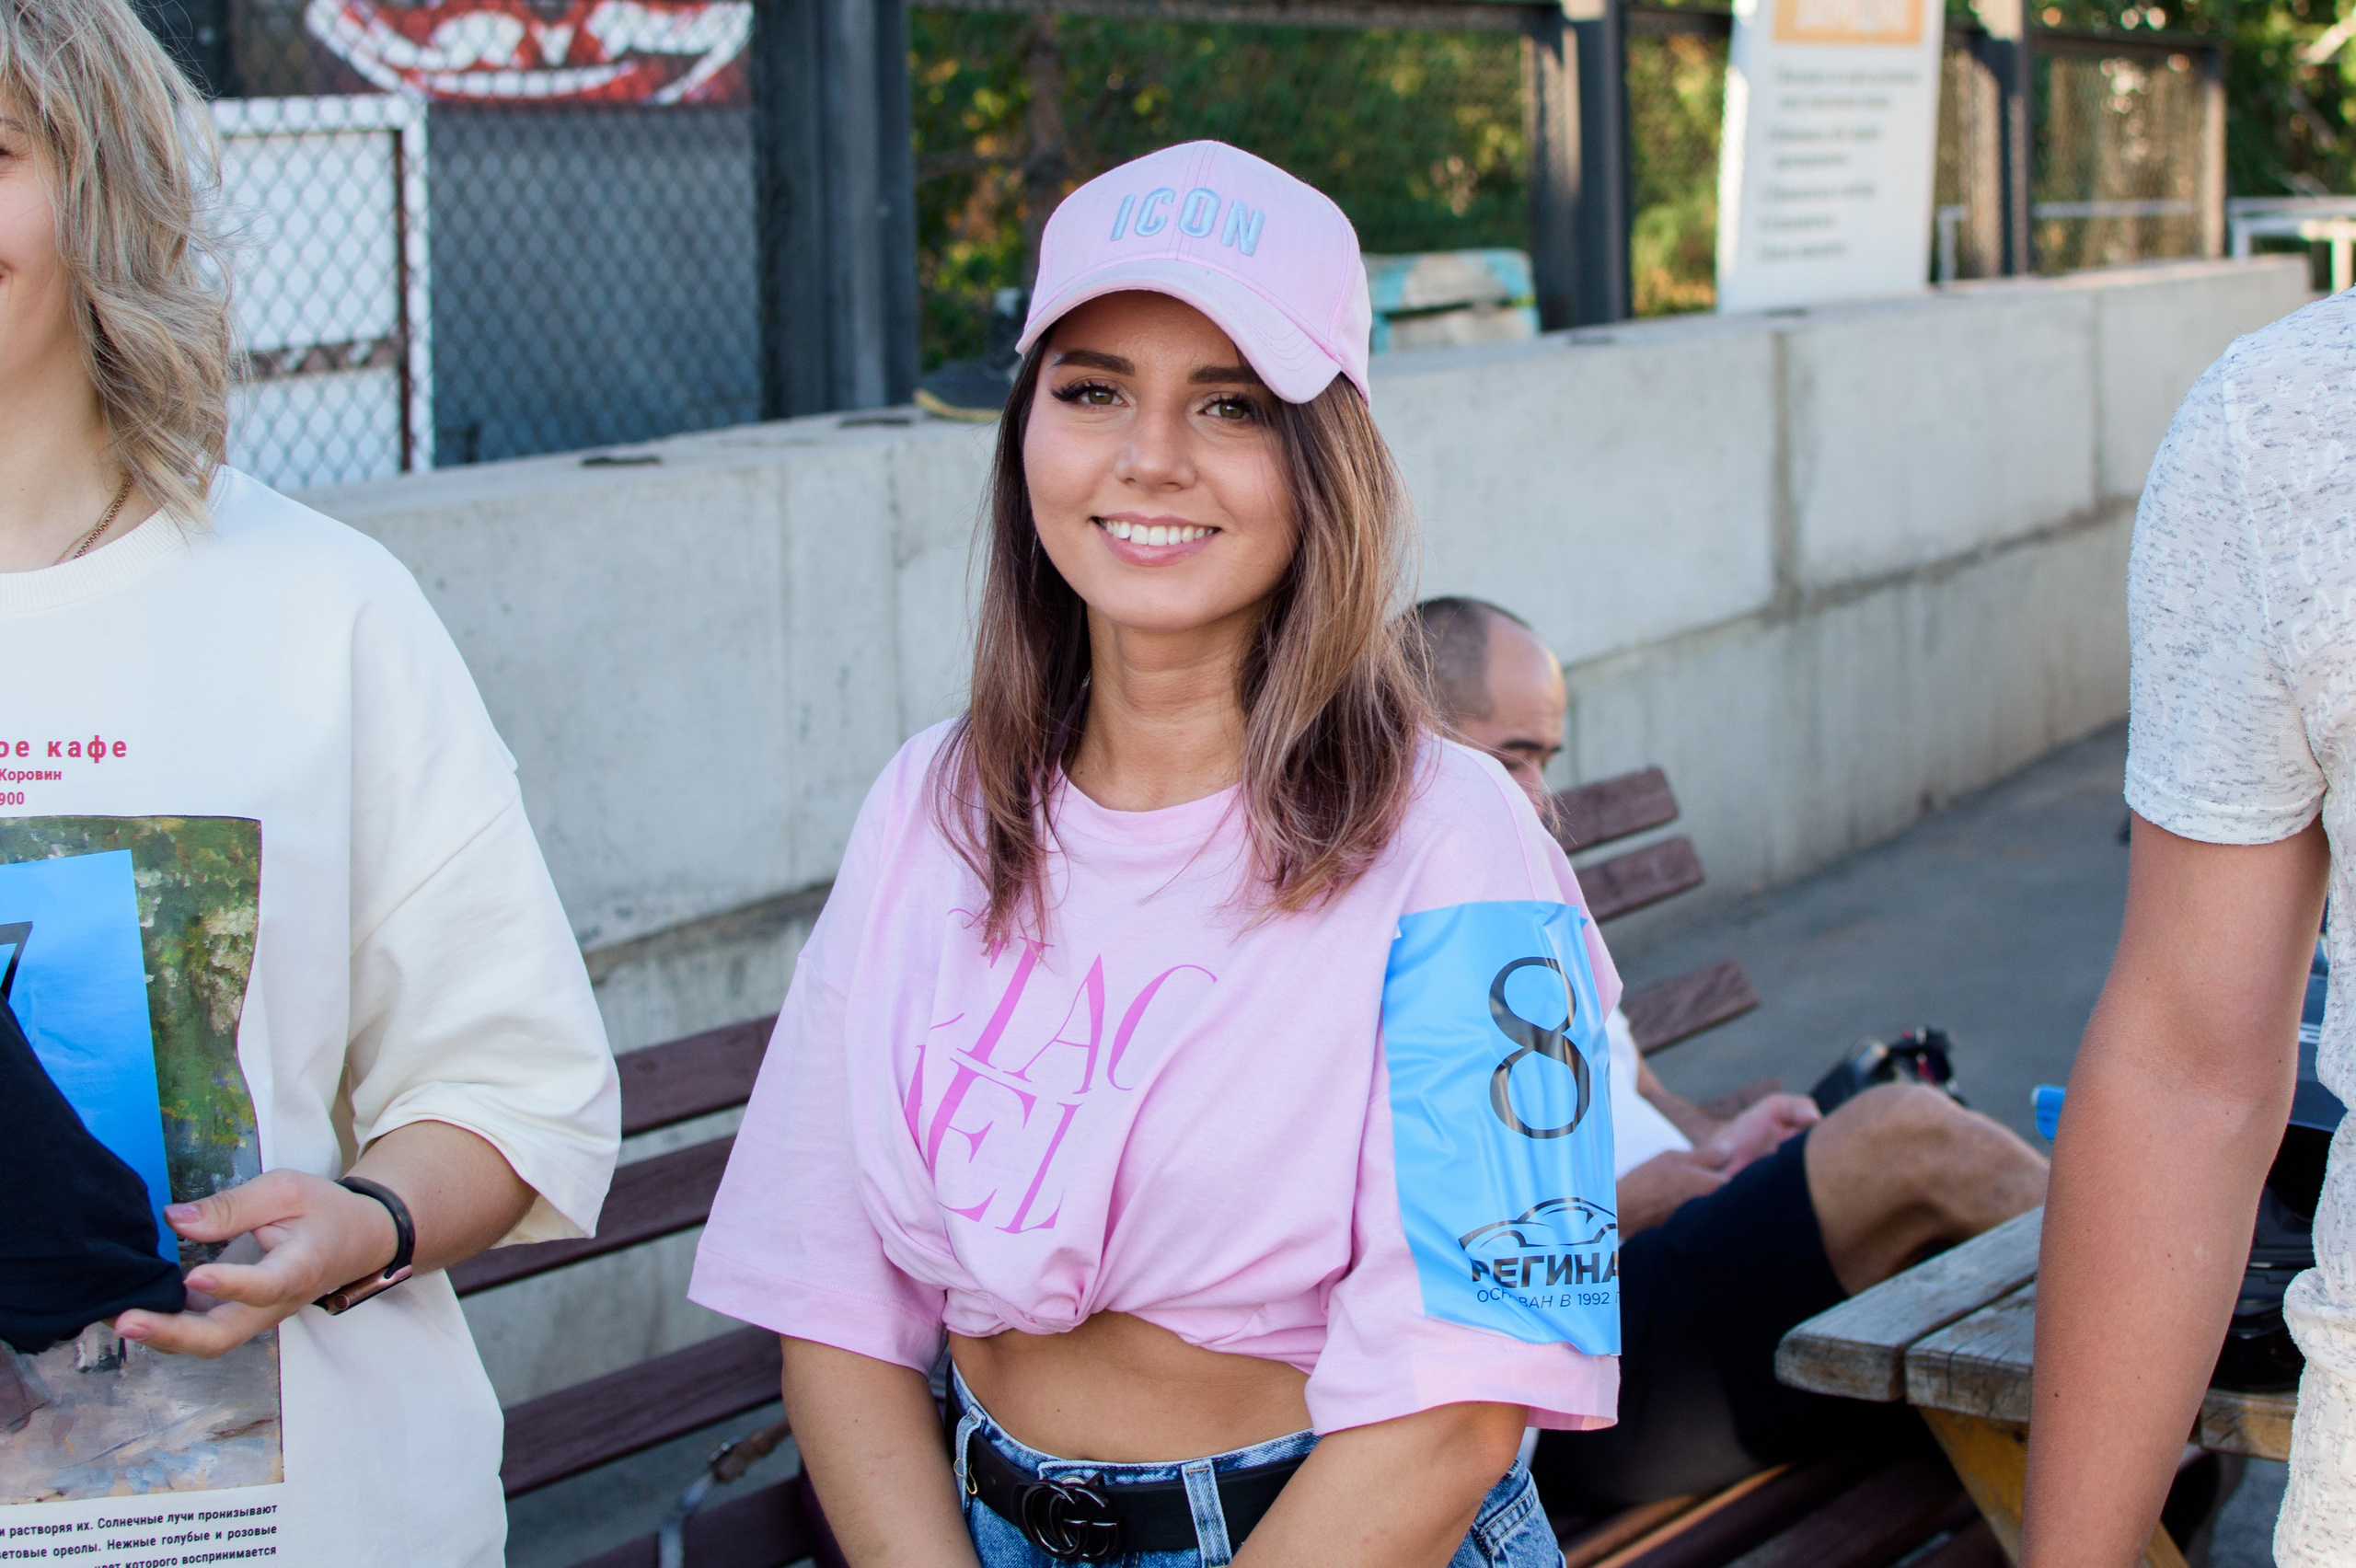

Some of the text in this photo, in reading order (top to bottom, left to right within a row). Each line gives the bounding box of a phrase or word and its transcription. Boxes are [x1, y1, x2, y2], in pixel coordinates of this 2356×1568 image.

[1110, 187, 1265, 258] ICON
[47, 735, 128, 764] кафе
[0, 767, 62, 783] Коровин
[0, 791, 25, 805] 900
[1577, 1291, 1611, 1306] 1992
[9, 1523, 73, 1539] растворяя
[76, 1520, 94, 1532] их.
[97, 1513, 164, 1529] Солнечные
[167, 1510, 194, 1526] лучи
[197, 1503, 278, 1523] пронизывают
[0, 1525, 278, 1560] етовые ореолы. Нежные голубые и розовые
[181, 1545, 277, 1565] воспринимается
